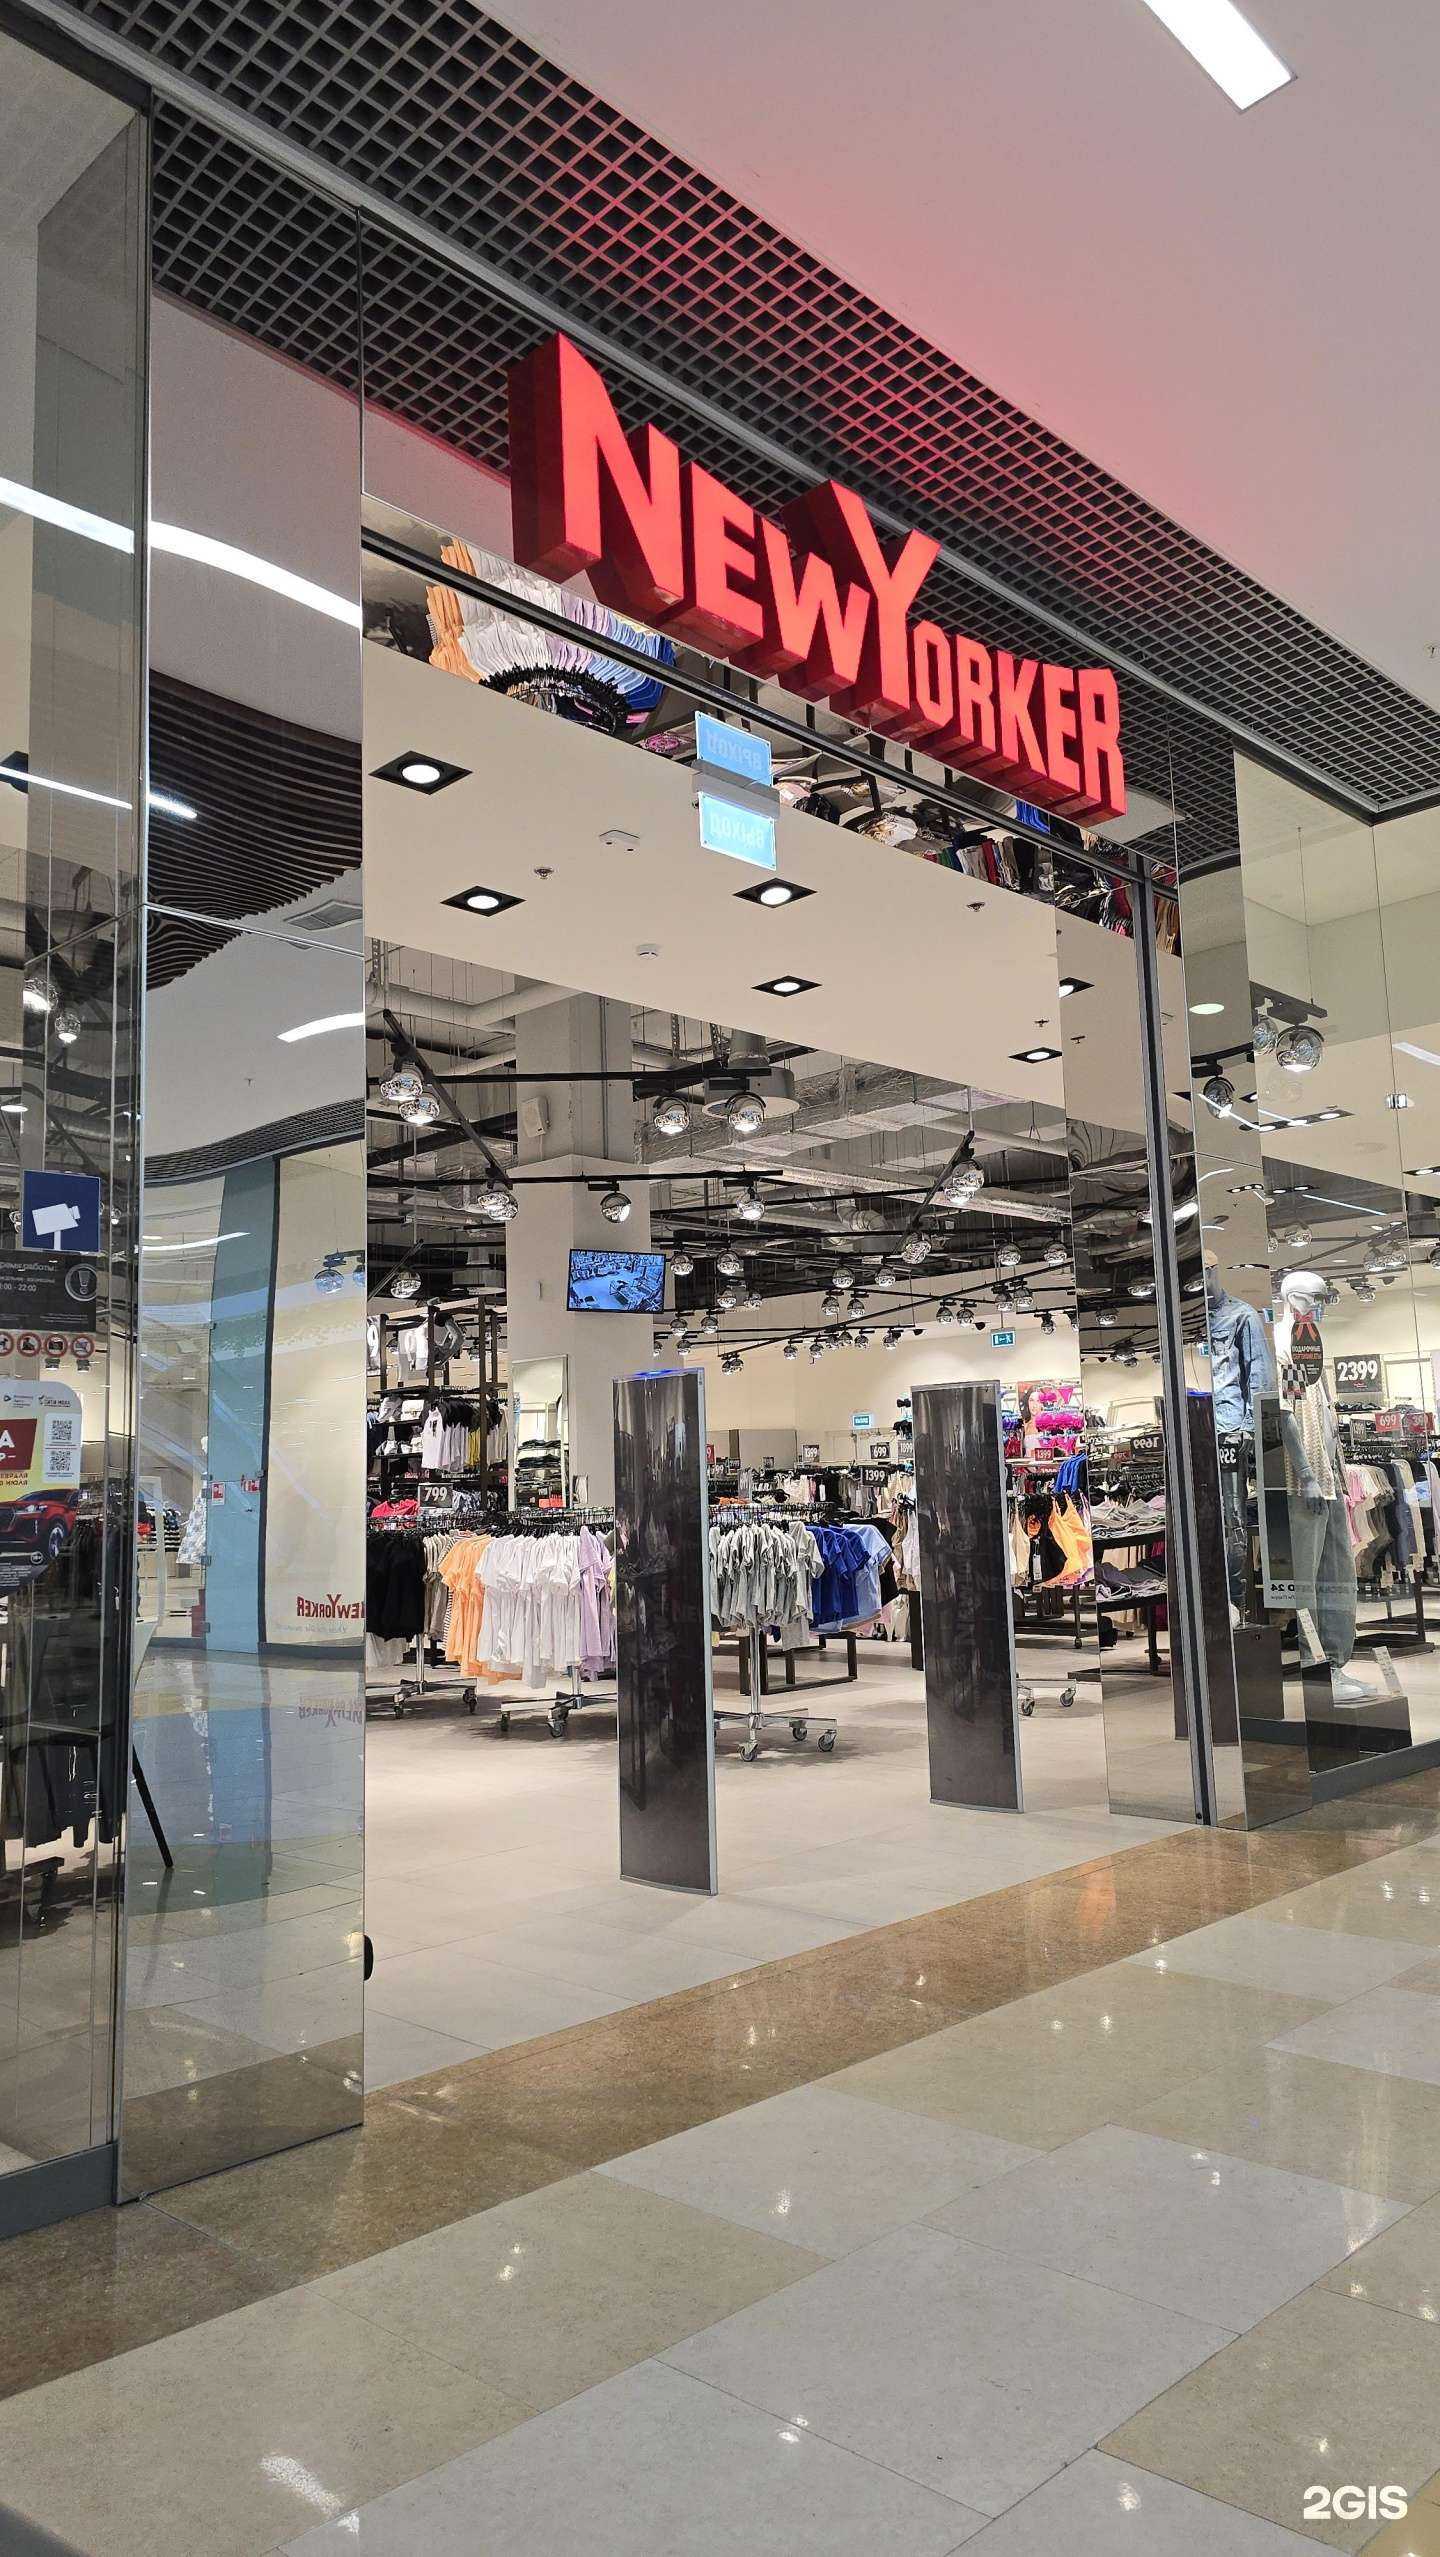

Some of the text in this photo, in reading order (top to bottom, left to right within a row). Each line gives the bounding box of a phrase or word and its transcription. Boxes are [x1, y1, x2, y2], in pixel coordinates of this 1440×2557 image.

[1337, 1360, 1378, 1382] 2399
[864, 1469, 886, 1482] 1399
[424, 1486, 448, 1501] 799
